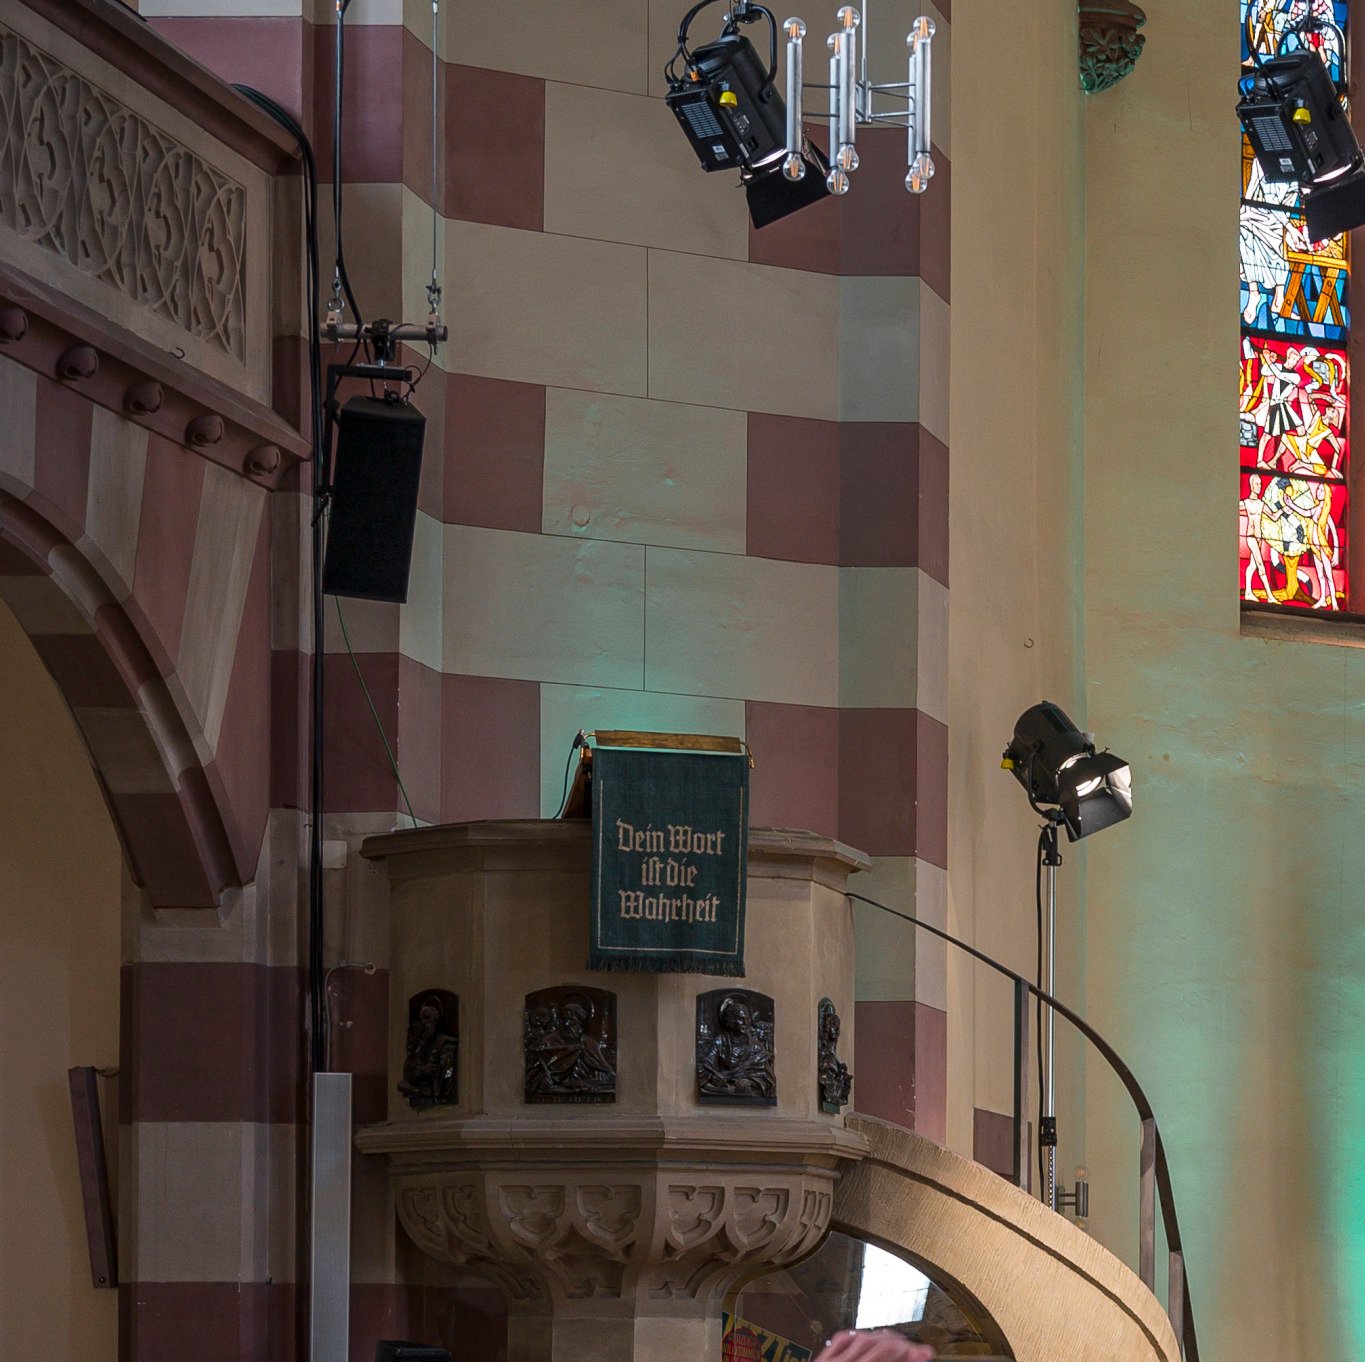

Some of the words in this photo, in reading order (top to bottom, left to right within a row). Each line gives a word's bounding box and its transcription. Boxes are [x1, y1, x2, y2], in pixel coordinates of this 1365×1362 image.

[616, 818, 665, 852] Dein
[667, 824, 725, 855] Wort
[666, 857, 698, 887] die
[618, 889, 720, 923] Wahrheit
